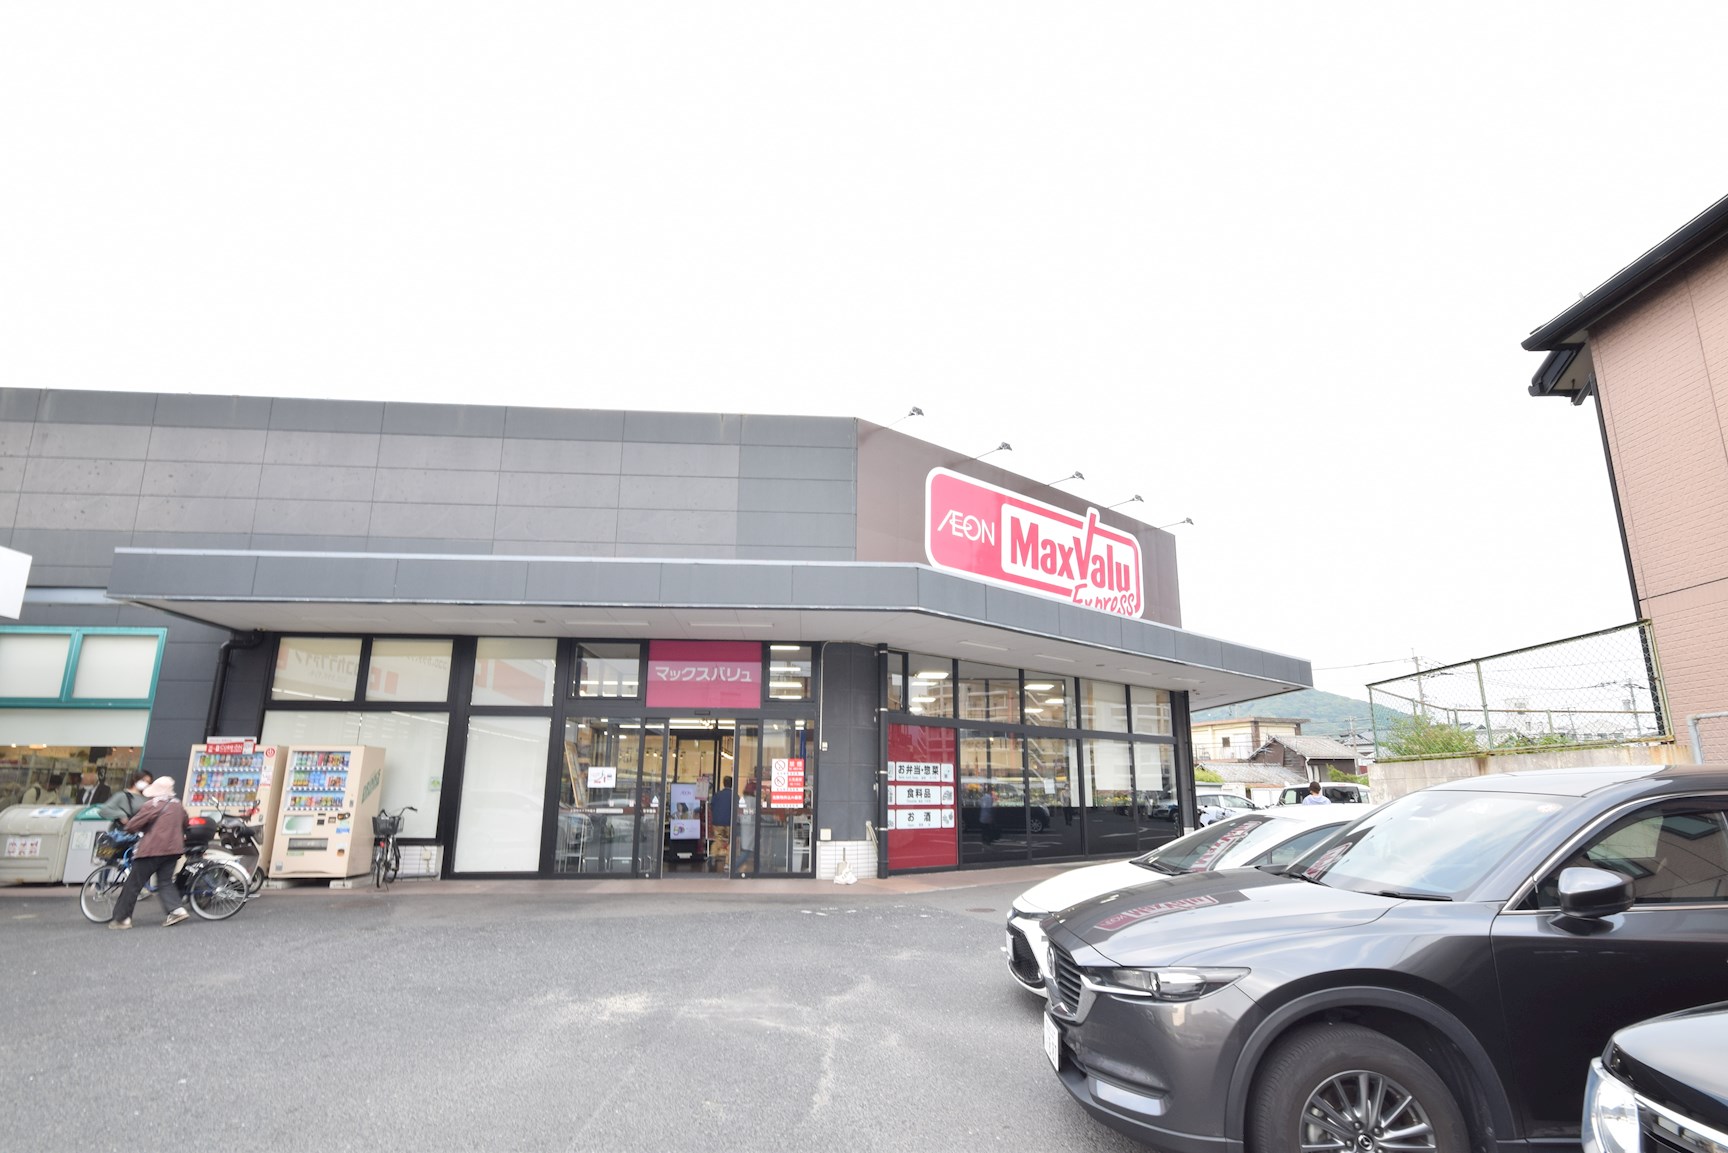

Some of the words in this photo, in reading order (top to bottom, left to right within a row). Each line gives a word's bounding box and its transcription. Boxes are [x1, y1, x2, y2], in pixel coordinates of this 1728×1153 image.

[1010, 513, 1130, 592] MaxValu
[655, 665, 752, 683] マックスバリュ
[898, 764, 939, 775] お弁当・惣菜
[907, 788, 931, 799] 食料品
